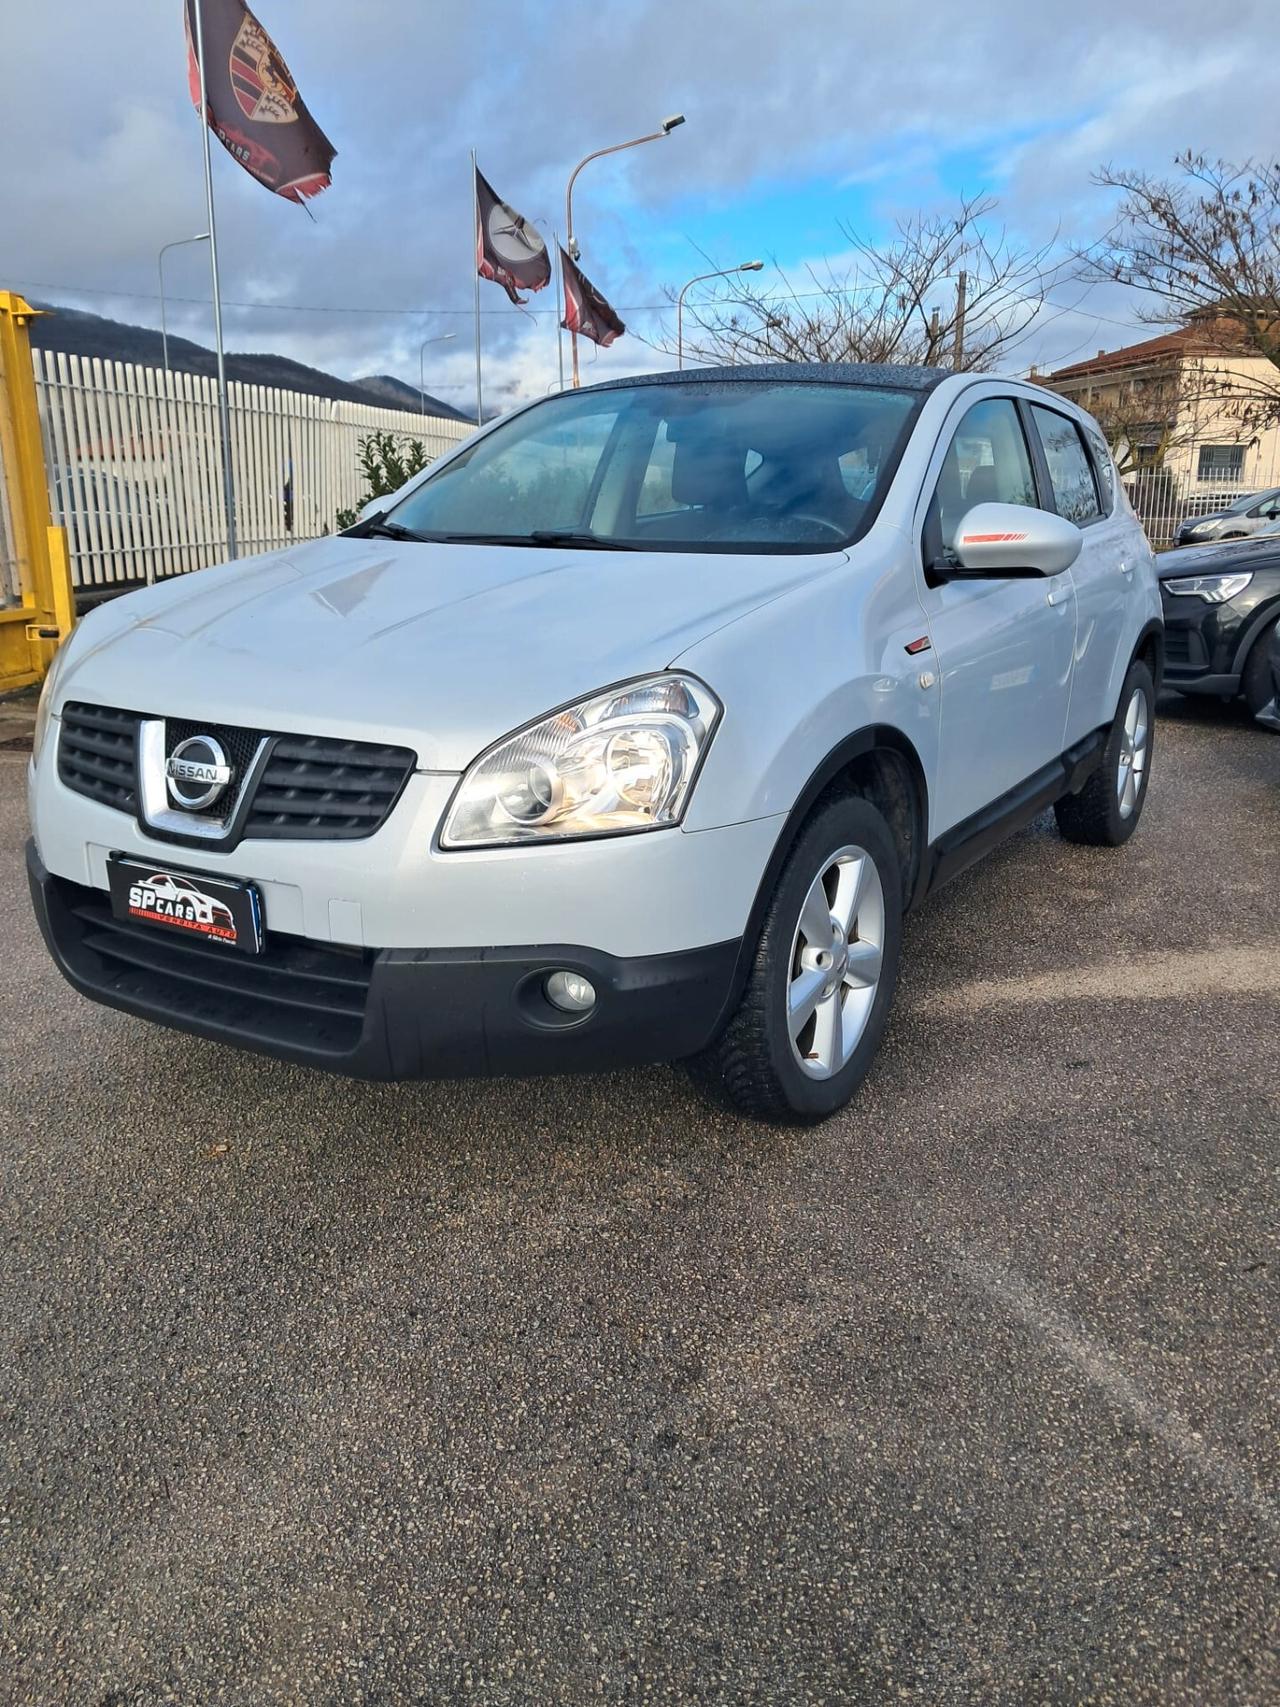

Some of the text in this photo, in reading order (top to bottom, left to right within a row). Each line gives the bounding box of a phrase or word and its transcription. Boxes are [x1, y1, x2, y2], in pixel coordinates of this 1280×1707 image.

[167, 762, 218, 780] NISSAN
[159, 913, 236, 938] VENDITA AUTO
